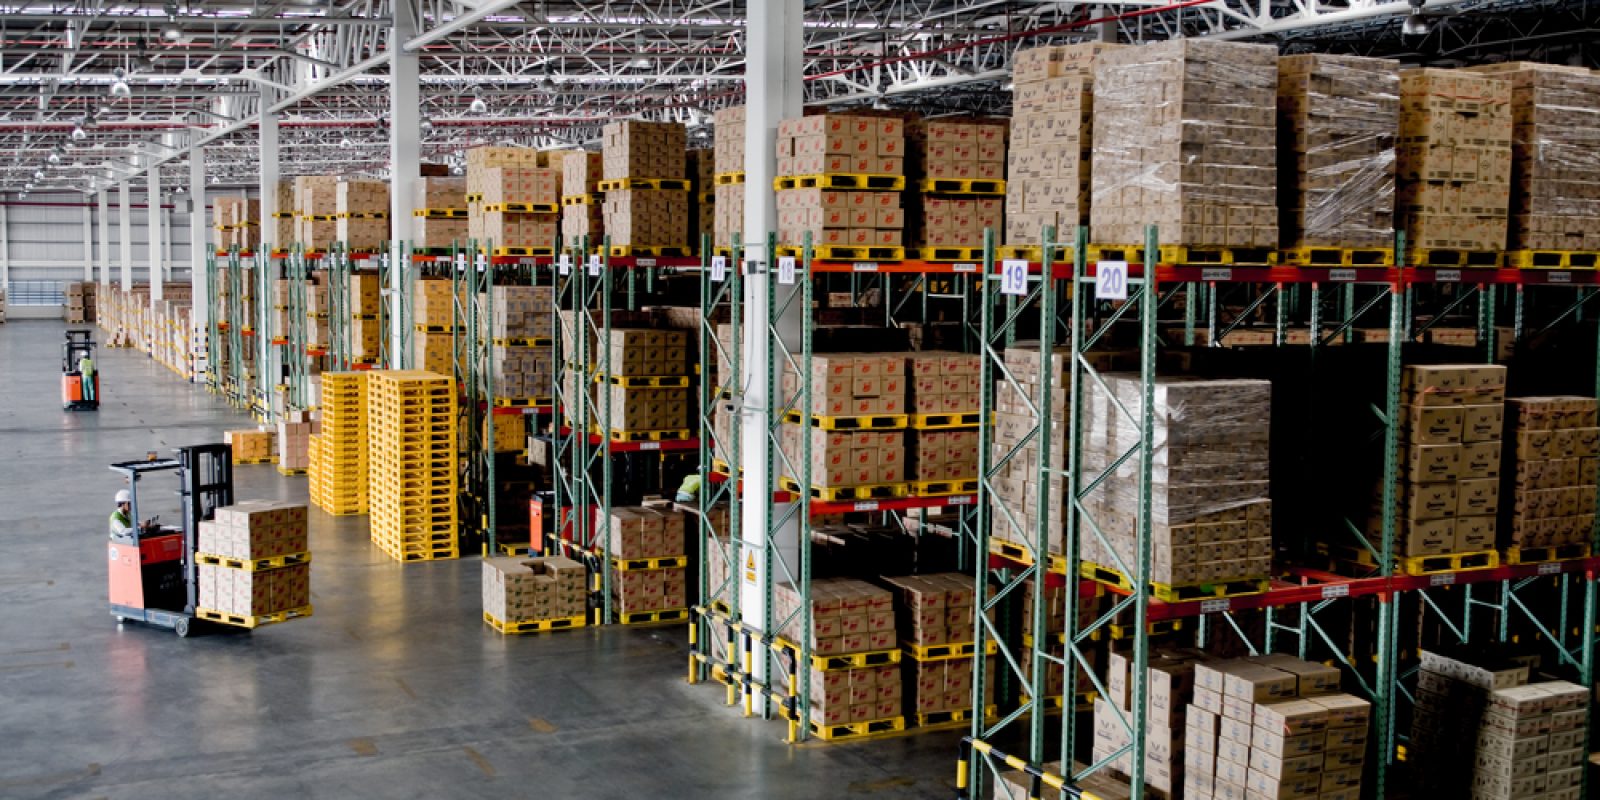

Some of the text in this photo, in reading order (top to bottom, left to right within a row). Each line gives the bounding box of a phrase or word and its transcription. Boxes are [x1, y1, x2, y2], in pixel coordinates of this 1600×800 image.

[782, 261, 792, 280] 18
[1007, 265, 1023, 290] 19
[1102, 267, 1122, 293] 20
